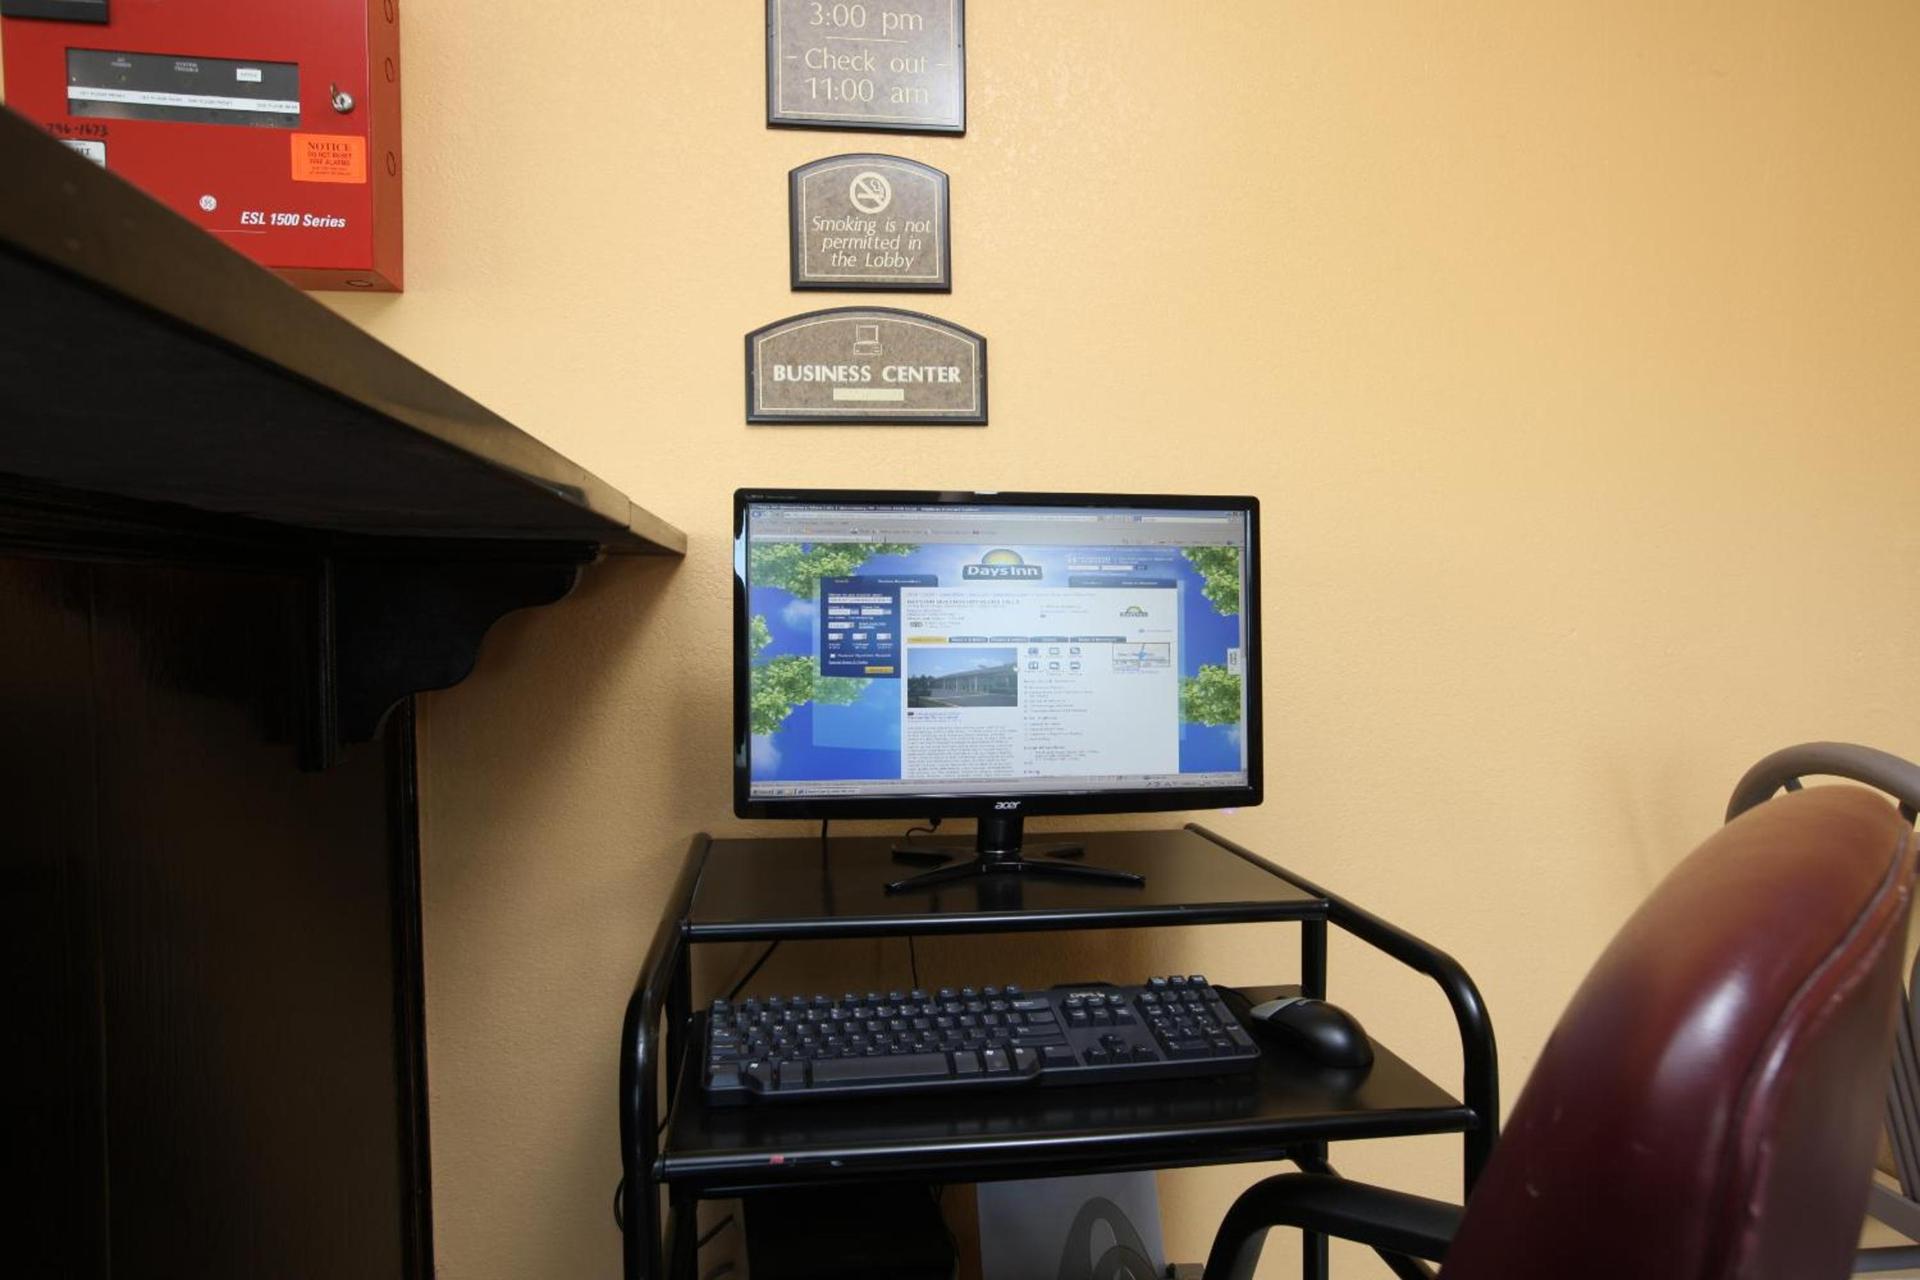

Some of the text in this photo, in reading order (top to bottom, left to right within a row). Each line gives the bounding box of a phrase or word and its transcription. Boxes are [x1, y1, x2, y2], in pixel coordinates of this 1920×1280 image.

[808, 2, 924, 36] 3:00 pm
[804, 48, 929, 74] Check out
[804, 77, 930, 104] 11:00 am
[307, 141, 352, 152] NOTICE
[241, 211, 347, 228] ESL 1500 Series
[811, 216, 932, 236] Smoking is not
[821, 235, 922, 252] permitted in
[831, 252, 915, 272] the Lobby
[773, 364, 962, 384] BUSINESS CENTER
[967, 566, 1009, 576] Days
[995, 801, 1021, 810] acer
